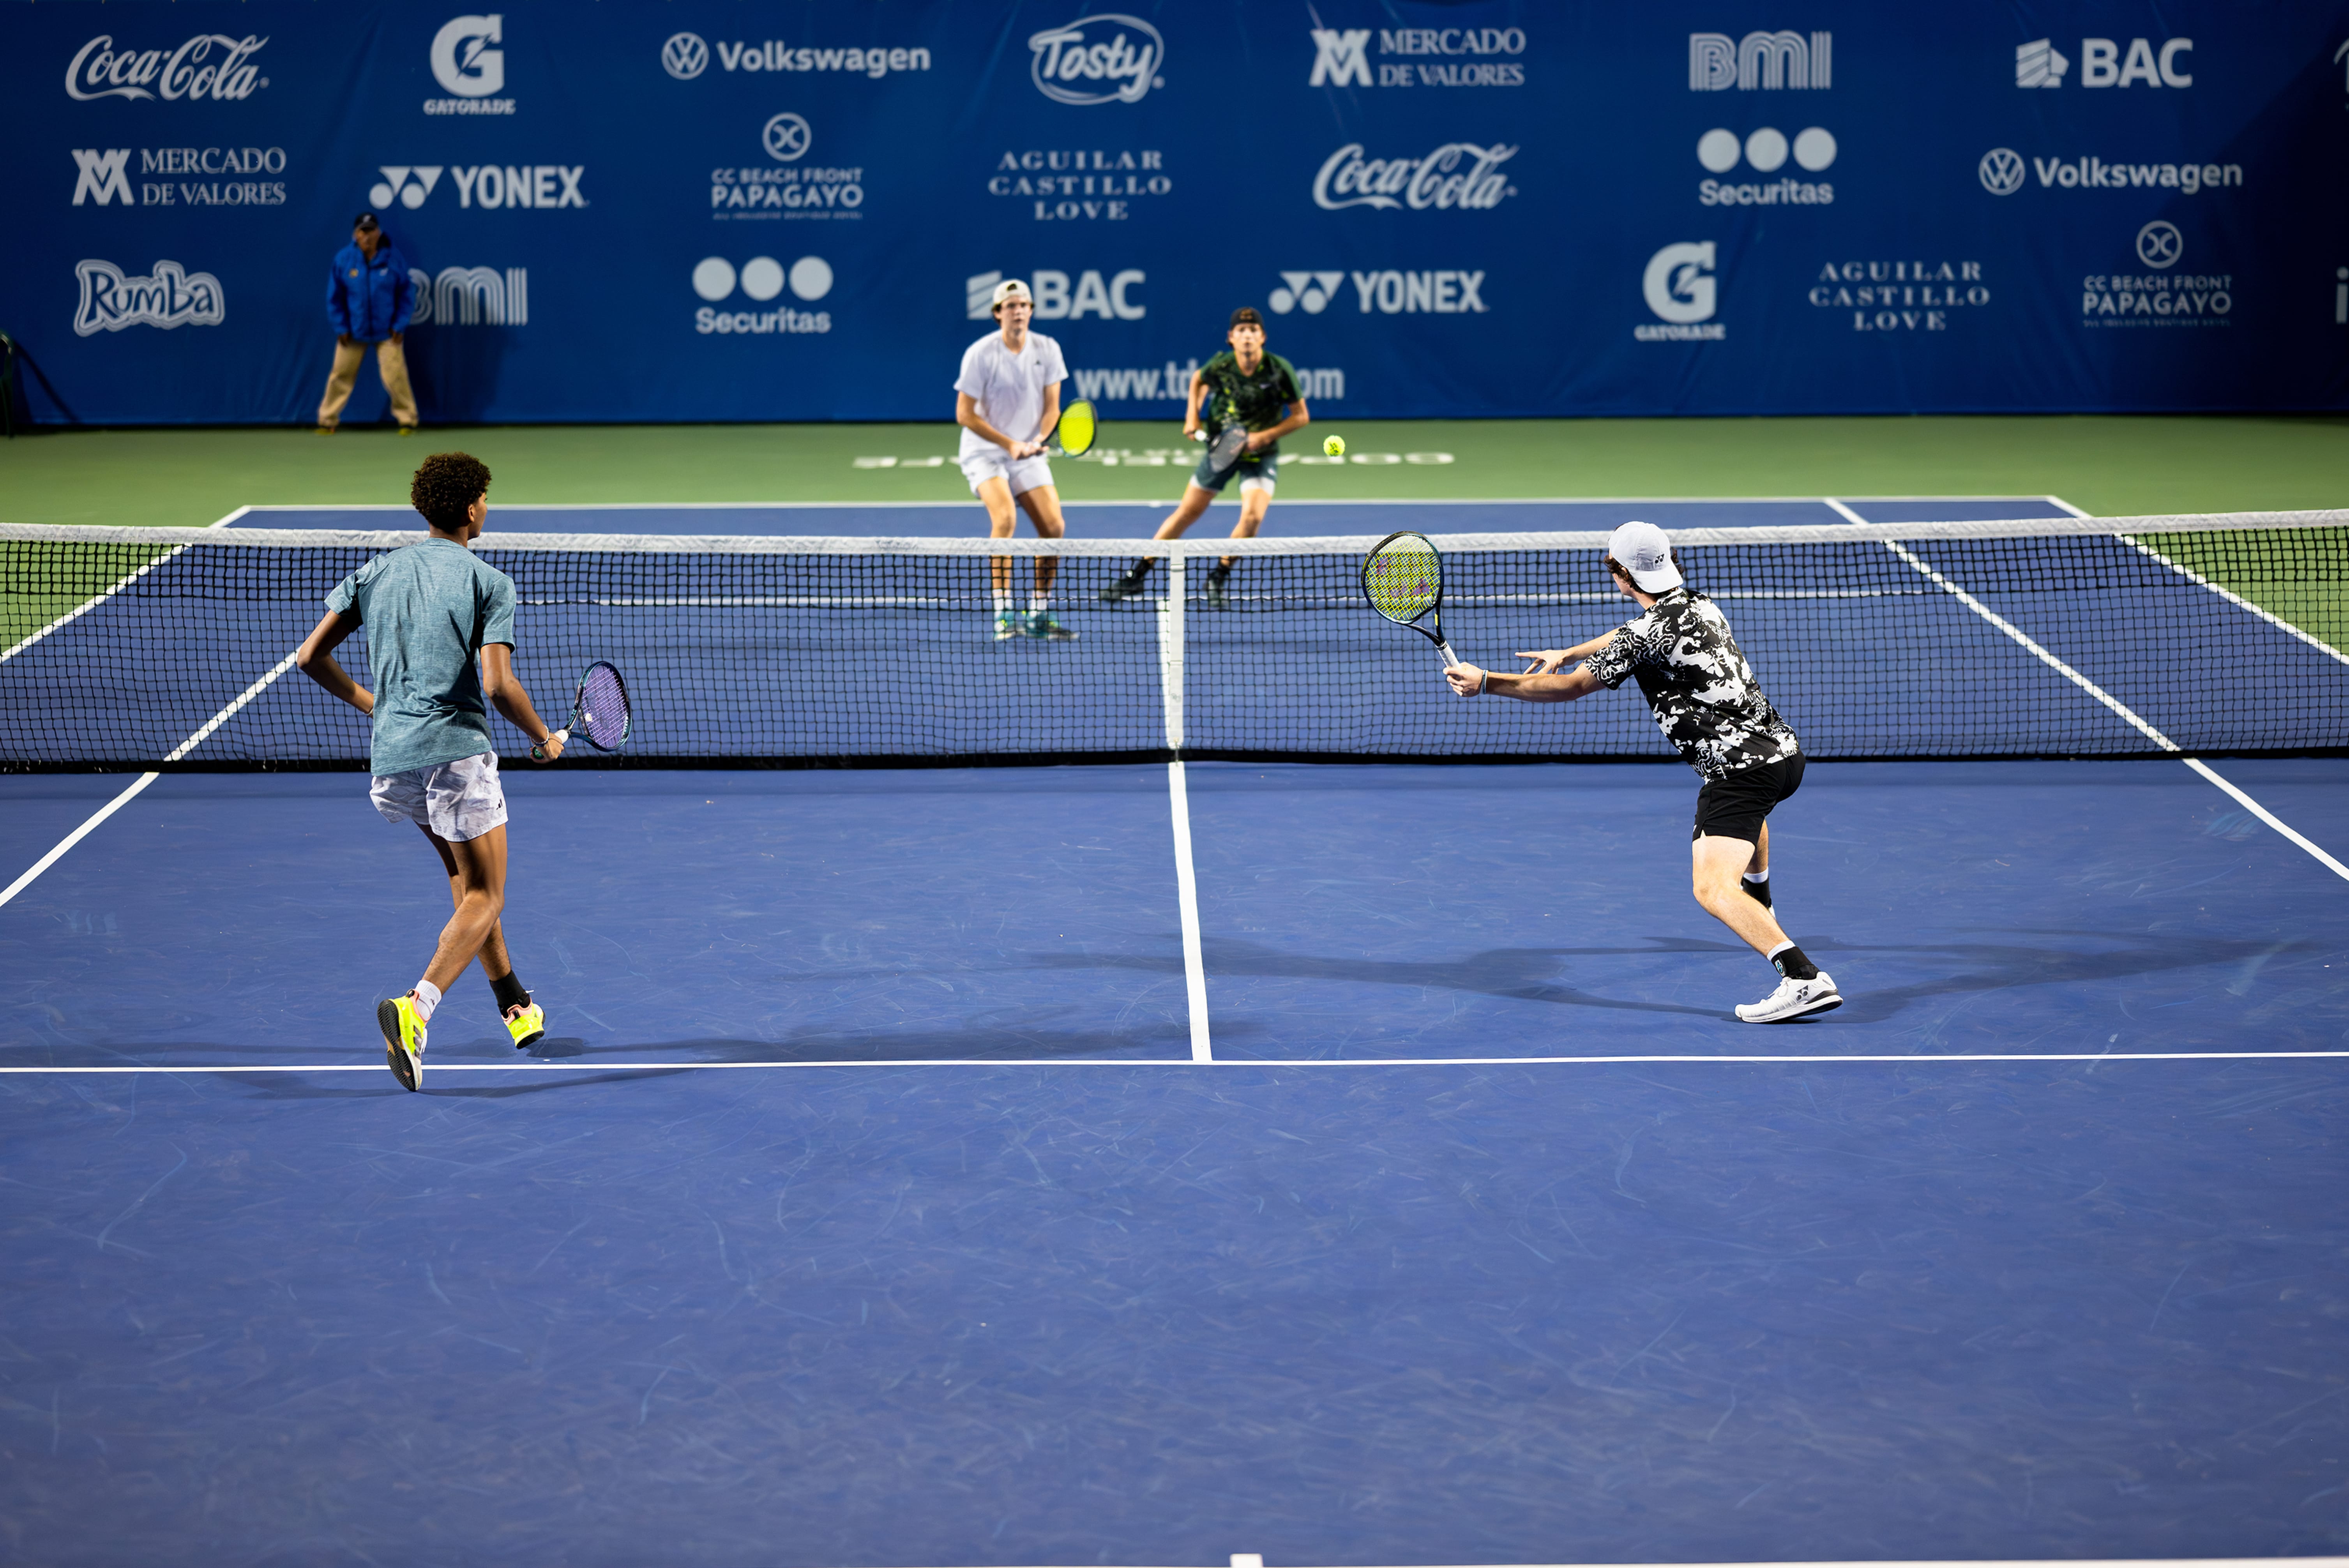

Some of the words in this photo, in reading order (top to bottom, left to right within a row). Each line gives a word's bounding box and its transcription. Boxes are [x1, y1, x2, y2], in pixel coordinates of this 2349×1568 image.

[1380, 28, 1526, 54] MERCADO
[65, 35, 268, 100] Coca-Cola
[717, 41, 930, 78] Volkswagen
[2082, 38, 2192, 87] BAC
[1380, 65, 1411, 86] DE
[1418, 64, 1524, 86] VALORES
[423, 98, 516, 115] GATORADE
[141, 148, 286, 173] MERCADO
[998, 150, 1162, 170] AGUILAR
[452, 166, 585, 208] YONEX
[712, 168, 735, 184] CC
[740, 168, 798, 184] BEACH
[803, 168, 863, 183] FRONT
[989, 176, 1171, 195] CASTILLO
[1313, 143, 1519, 209] Coca-Cola
[2034, 157, 2241, 193] Volkswagen
[143, 184, 175, 205] DE
[180, 183, 286, 205] VALORES
[712, 184, 864, 208] PAPAGAYO
[1699, 178, 1833, 205] Securitas
[1035, 201, 1127, 219] LOVE
[1819, 261, 1981, 281] AGUILAR
[2084, 275, 2107, 291] CC
[2112, 275, 2168, 291] BEACH
[2174, 275, 2231, 290] FRONT
[82, 268, 216, 327] Rumba
[1032, 270, 1145, 319] BAC
[1352, 270, 1485, 313] YONEX
[1809, 287, 1989, 306] CASTILLO
[2083, 292, 2231, 315] PAPAGAYO
[696, 307, 831, 334] Securitas
[1855, 312, 1945, 330] LOVE
[1634, 325, 1725, 341] GATORADE
